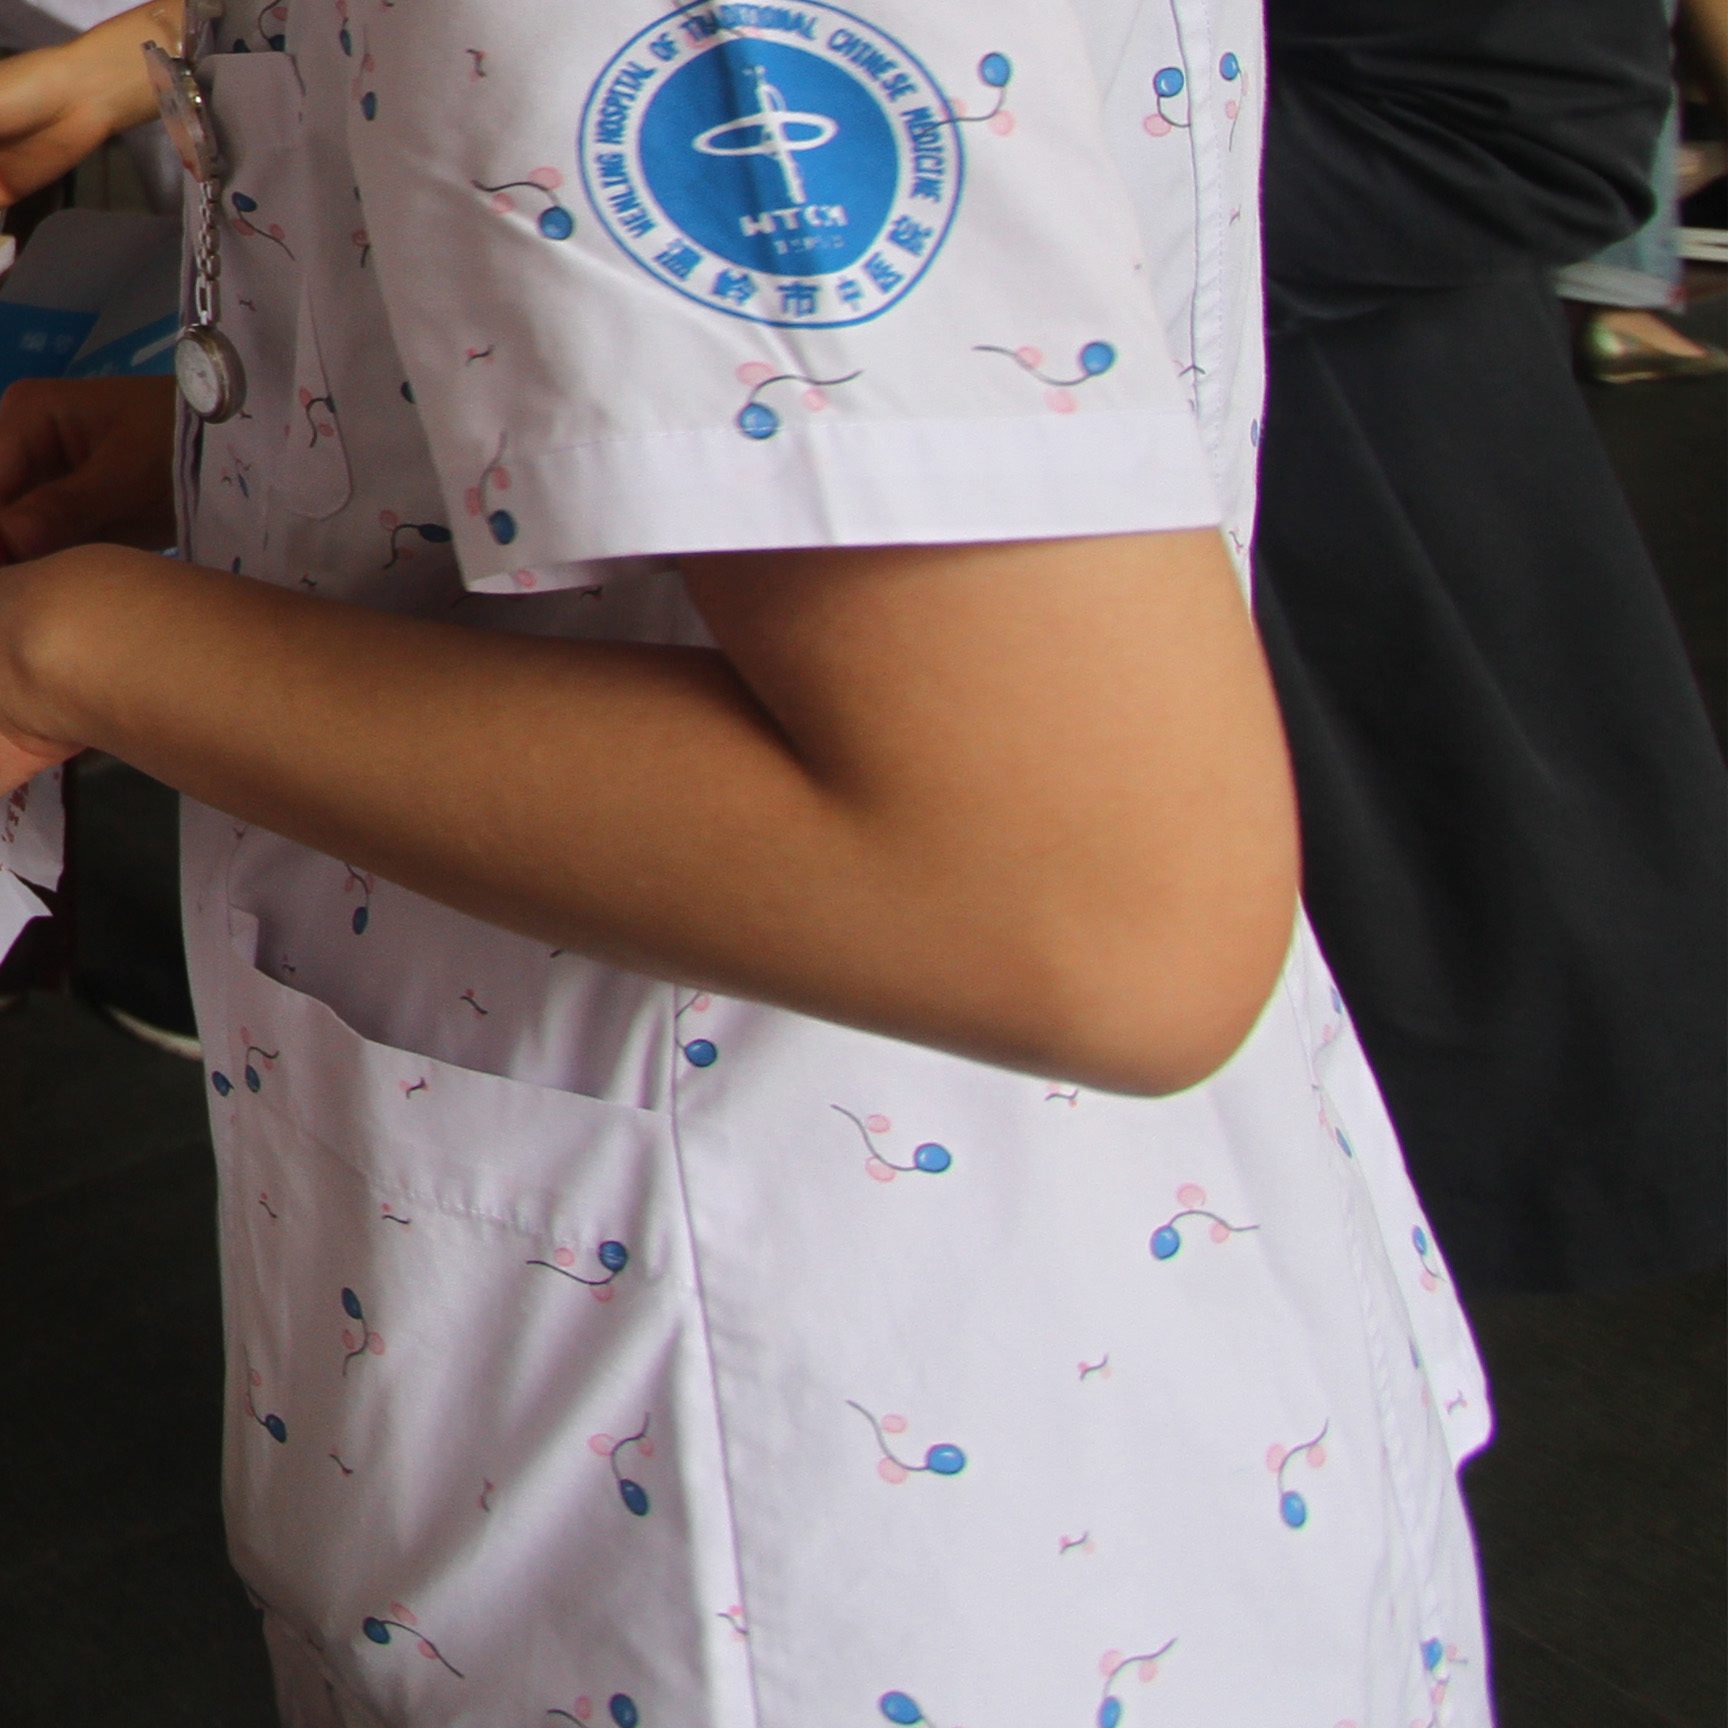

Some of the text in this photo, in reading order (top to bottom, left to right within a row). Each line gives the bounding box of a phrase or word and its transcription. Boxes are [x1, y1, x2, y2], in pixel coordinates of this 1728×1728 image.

[595, 61, 655, 144] HOSPITAL
[649, 32, 681, 62] OF
[828, 28, 917, 102] CHINESE
[901, 106, 945, 202] MEDICINE
